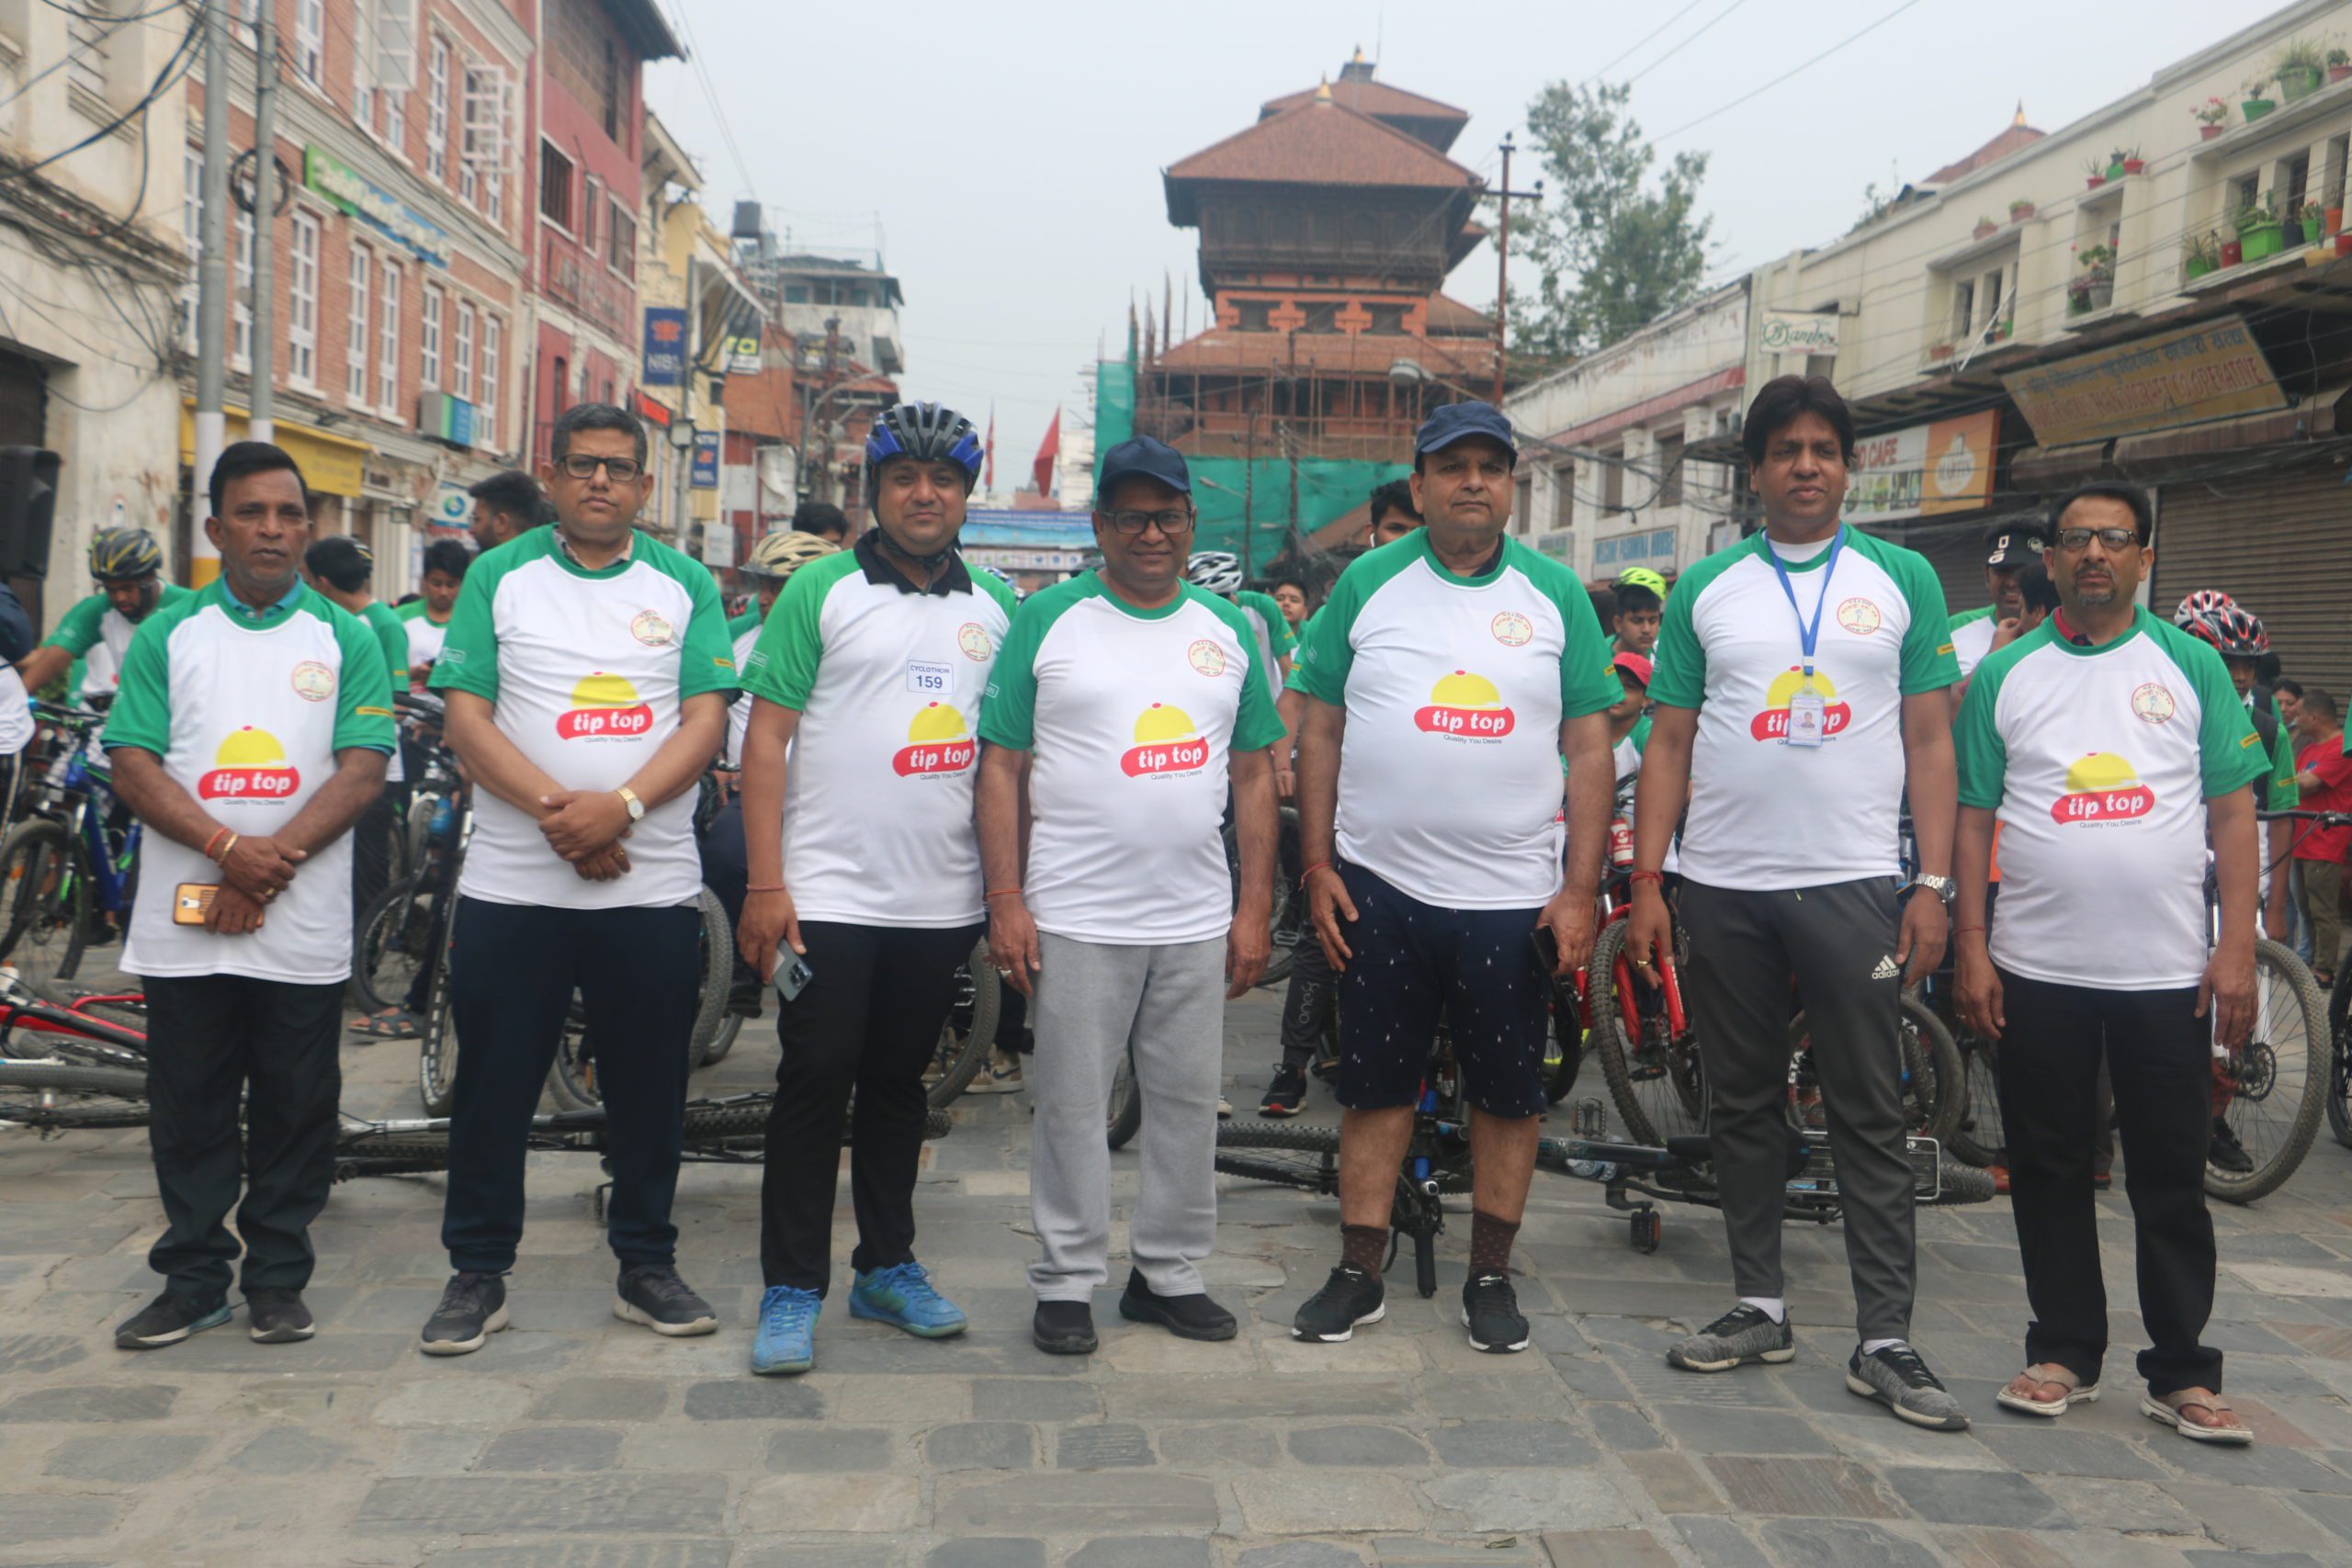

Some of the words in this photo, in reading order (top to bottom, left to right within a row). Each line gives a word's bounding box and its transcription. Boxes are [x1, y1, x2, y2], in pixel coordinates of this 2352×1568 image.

[910, 665, 950, 673] CYCLOTHON
[916, 674, 943, 689] 159
[573, 713, 605, 734] tip
[610, 711, 645, 731] top
[1432, 710, 1464, 732] tip
[1470, 713, 1506, 734] top
[1768, 714, 1789, 736] ti
[1442, 734, 1467, 744] Quality
[910, 750, 938, 771] tip
[944, 746, 970, 766] top
[1138, 750, 1167, 771] tip
[1172, 746, 1203, 764] top
[213, 773, 246, 795] tip
[252, 772, 291, 794] top
[2068, 797, 2099, 818] tip
[2106, 794, 2144, 814] top
[1871, 968, 1900, 980] adidas
